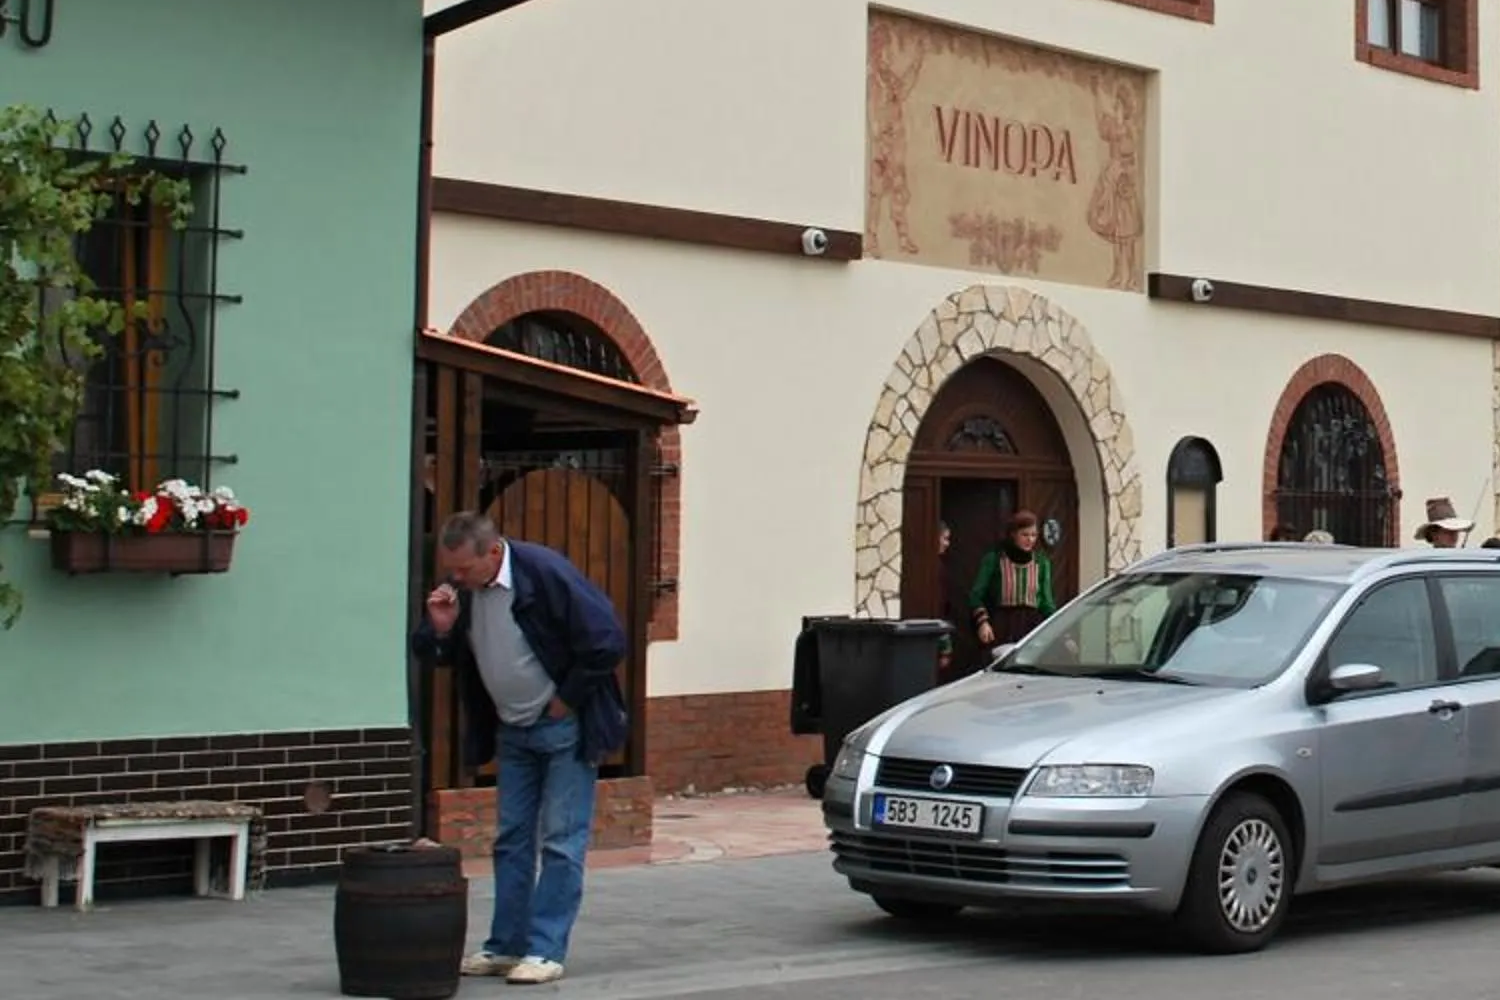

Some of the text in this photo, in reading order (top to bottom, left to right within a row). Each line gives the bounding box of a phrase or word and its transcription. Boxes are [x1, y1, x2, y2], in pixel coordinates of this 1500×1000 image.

[931, 104, 1077, 185] VINOPA
[887, 799, 972, 829] 5B3 1245
